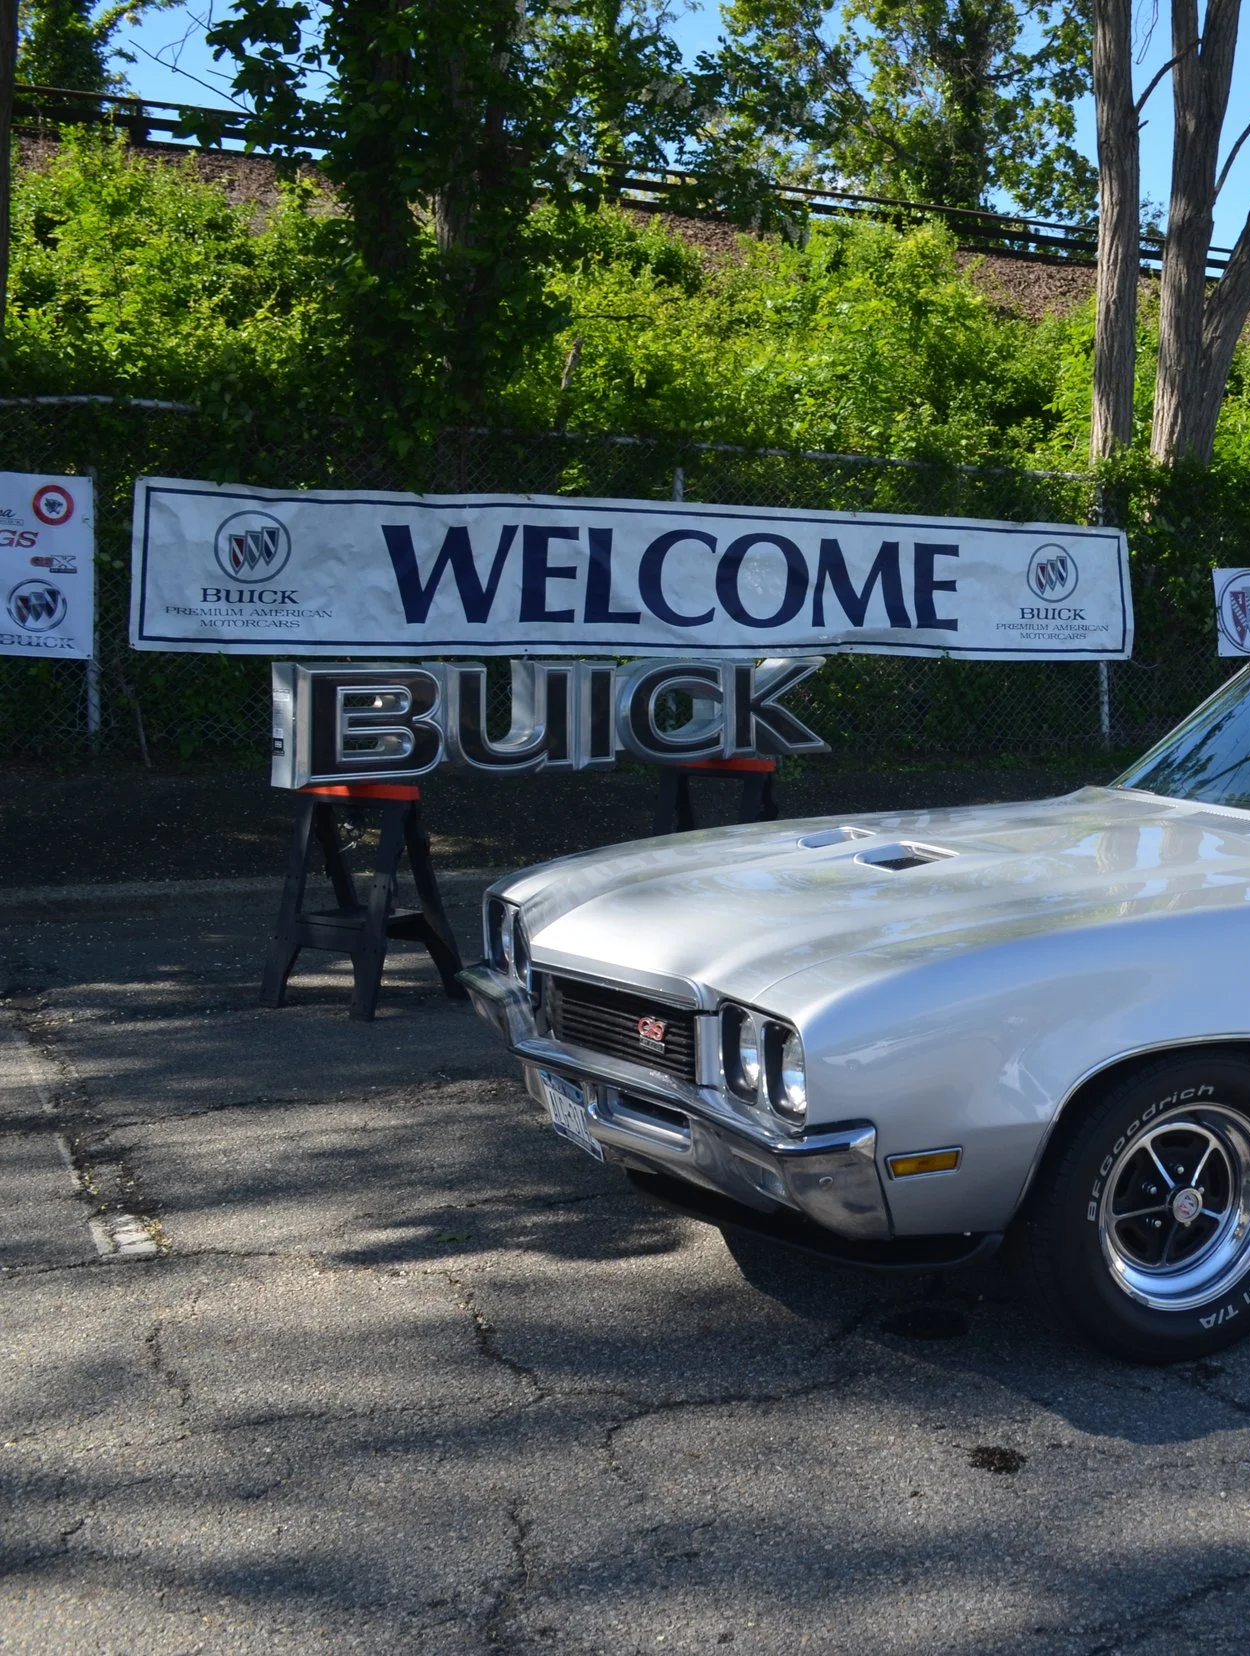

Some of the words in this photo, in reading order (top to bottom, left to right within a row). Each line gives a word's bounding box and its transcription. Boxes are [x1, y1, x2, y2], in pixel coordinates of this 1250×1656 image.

[382, 524, 960, 632] WELCOME
[201, 587, 300, 605] BUICK
[166, 605, 243, 617] PREMIUM
[250, 608, 333, 619] AMERICAN
[1019, 607, 1087, 621] BUICK
[200, 619, 300, 629] MOTORCARS
[996, 623, 1049, 631] PREMIUM
[1052, 624, 1109, 633] AMERICAN
[1020, 633, 1087, 641] MOTORCARS
[290, 657, 830, 786] BUICK
[1087, 1084, 1215, 1222] BFGoodrich
[1199, 1304, 1240, 1329] T/A
